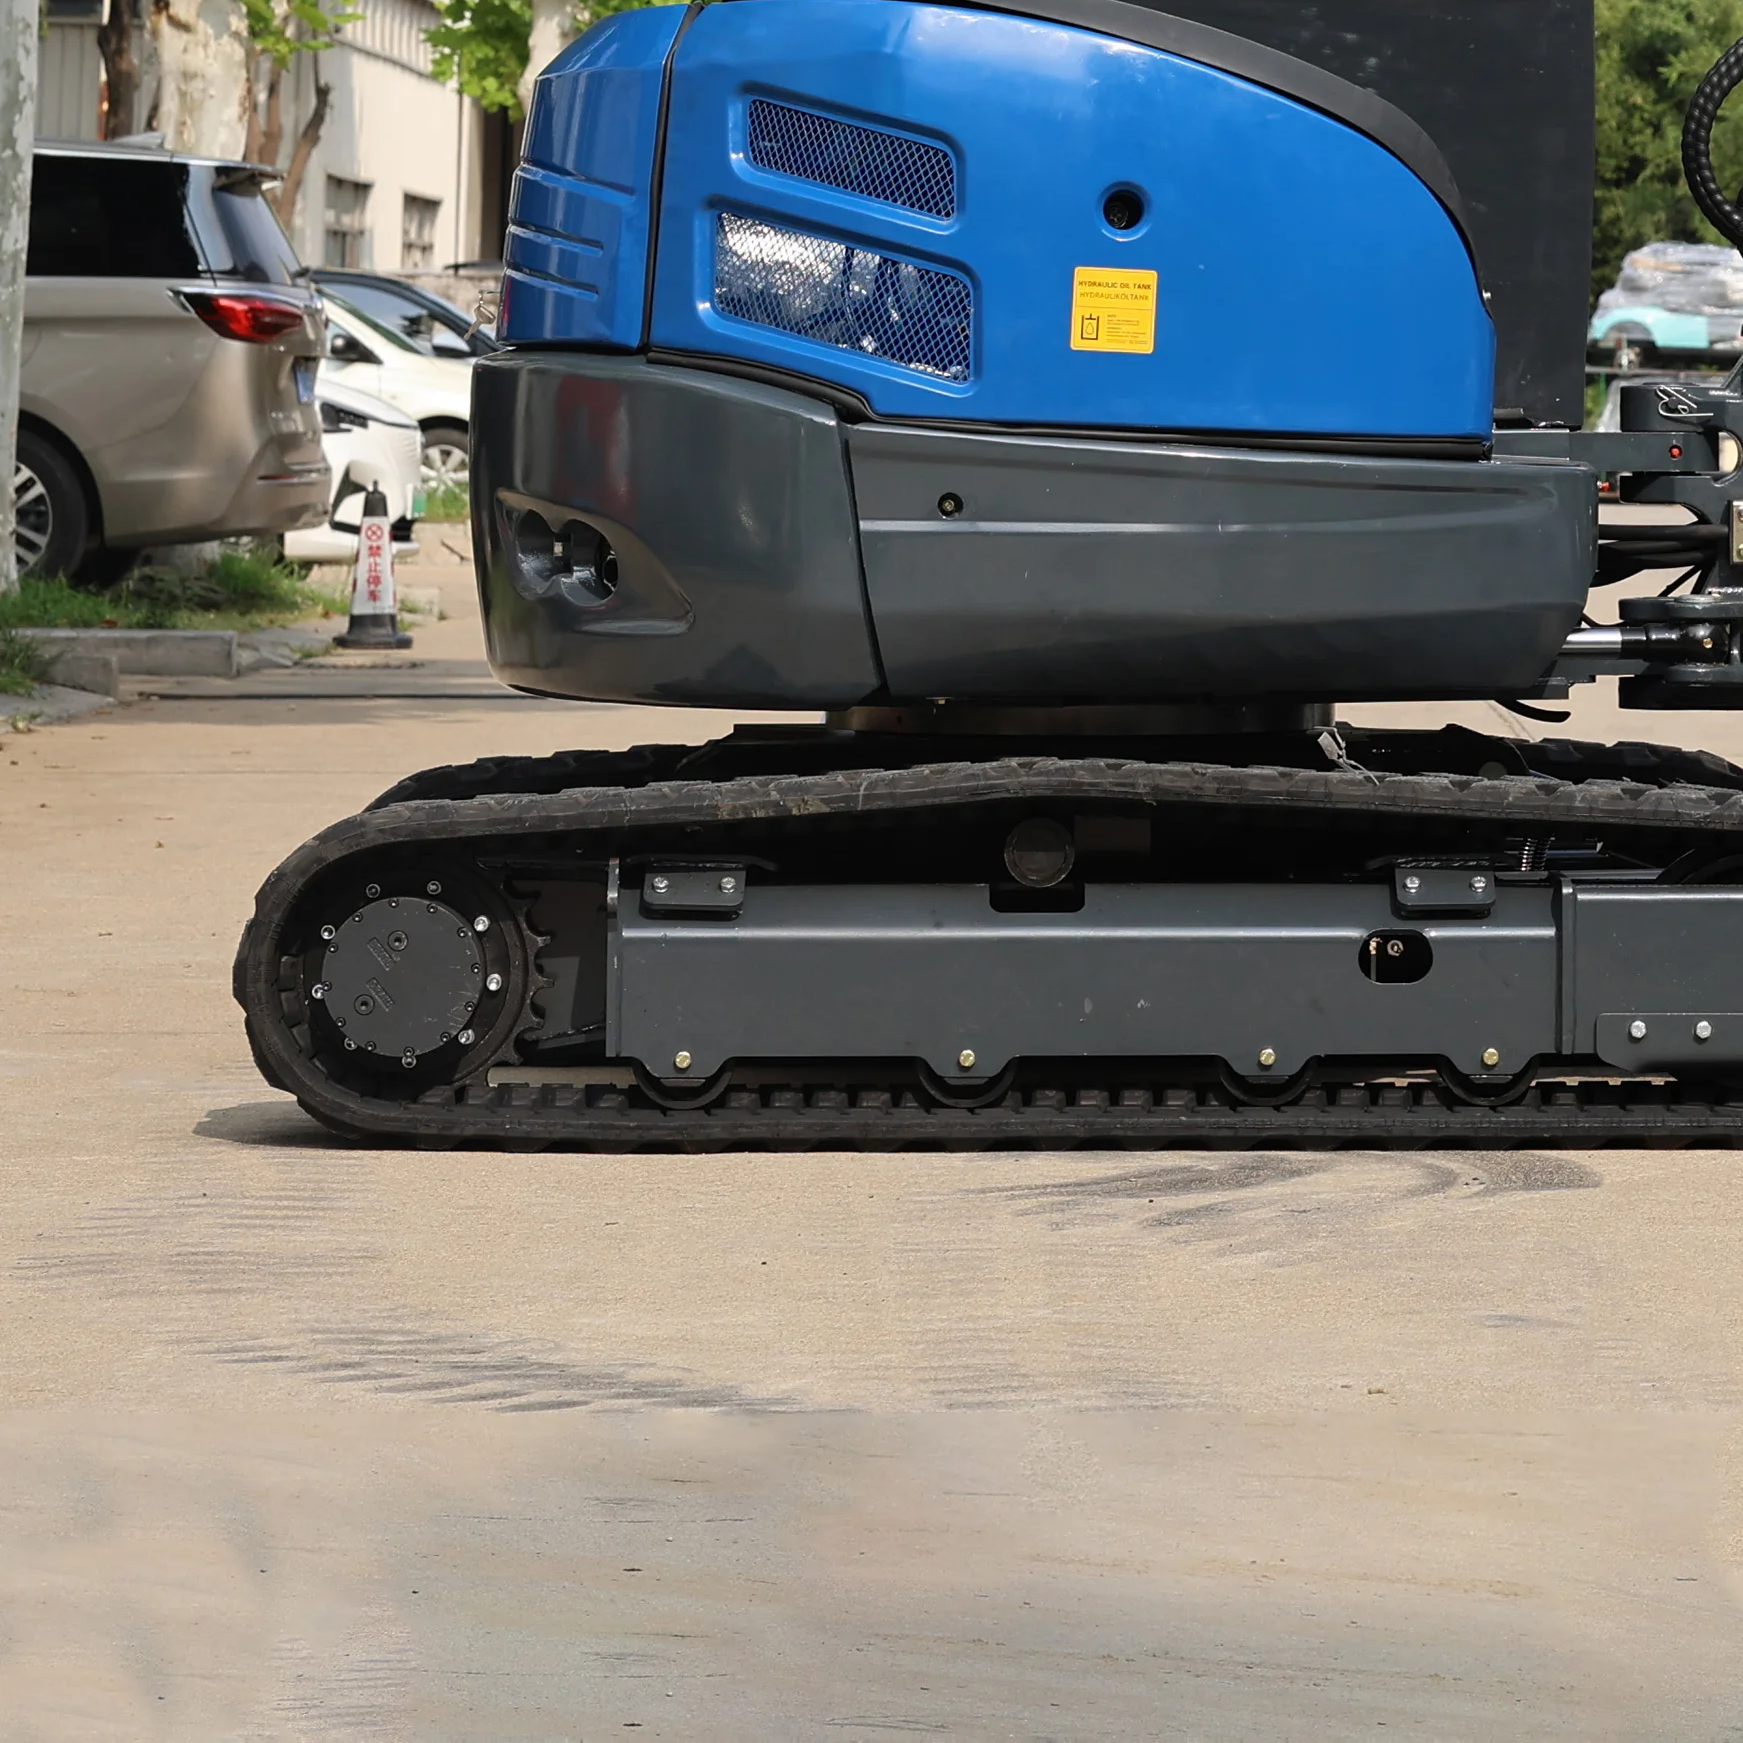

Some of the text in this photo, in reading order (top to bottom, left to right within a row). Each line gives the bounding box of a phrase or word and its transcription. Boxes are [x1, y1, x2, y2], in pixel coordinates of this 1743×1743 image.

[1078, 280, 1118, 288] HYDRAULIC
[367, 544, 382, 603] 禁止停车
